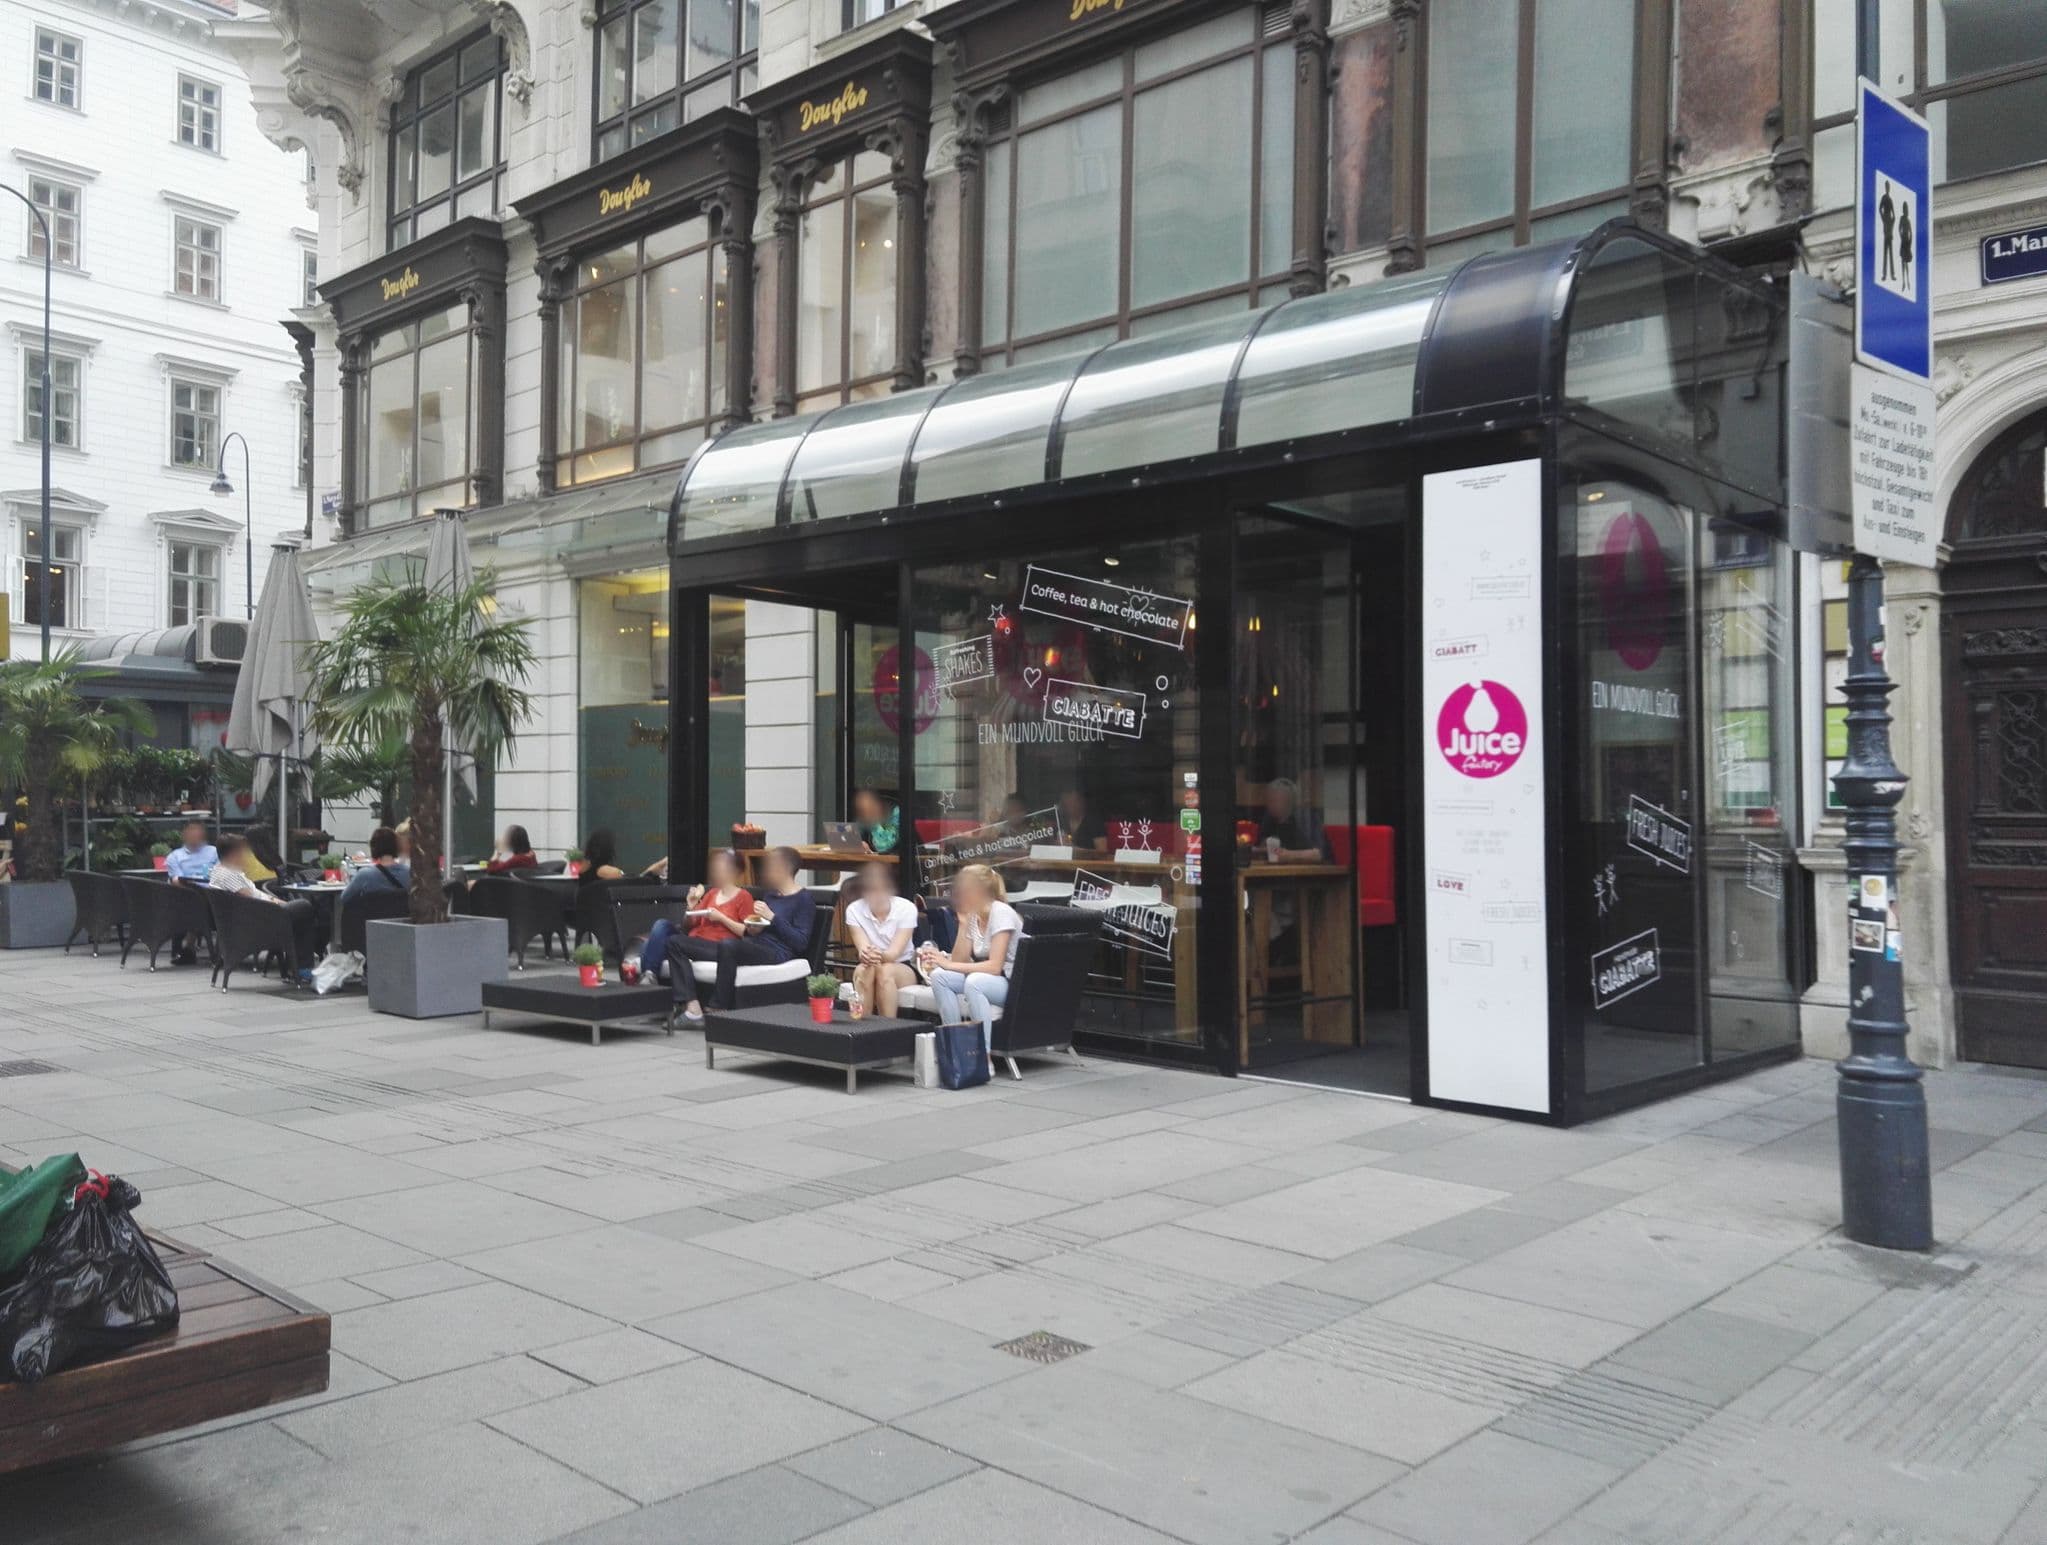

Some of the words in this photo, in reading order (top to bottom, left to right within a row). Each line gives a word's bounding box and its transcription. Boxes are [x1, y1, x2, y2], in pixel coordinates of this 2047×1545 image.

[800, 81, 868, 132] Douglas
[600, 173, 651, 215] Douglas
[1031, 583, 1068, 603] Coffee,
[1069, 594, 1088, 609] tea
[1089, 597, 1098, 610] &
[1100, 599, 1119, 617] hot
[1120, 604, 1179, 629] chocolate
[944, 650, 983, 679] SHAKES
[1052, 696, 1135, 729] CIABATTE
[978, 723, 998, 744] EIN
[1002, 720, 1064, 743] MUNDVOLL
[1444, 727, 1521, 757] Juice
[958, 846, 975, 861] tea
[975, 844, 983, 856] &
[985, 839, 1002, 854] hot
[1003, 826, 1054, 848] chocolate
[1632, 808, 1658, 846] FRESH
[1437, 879, 1464, 891] LOVE
